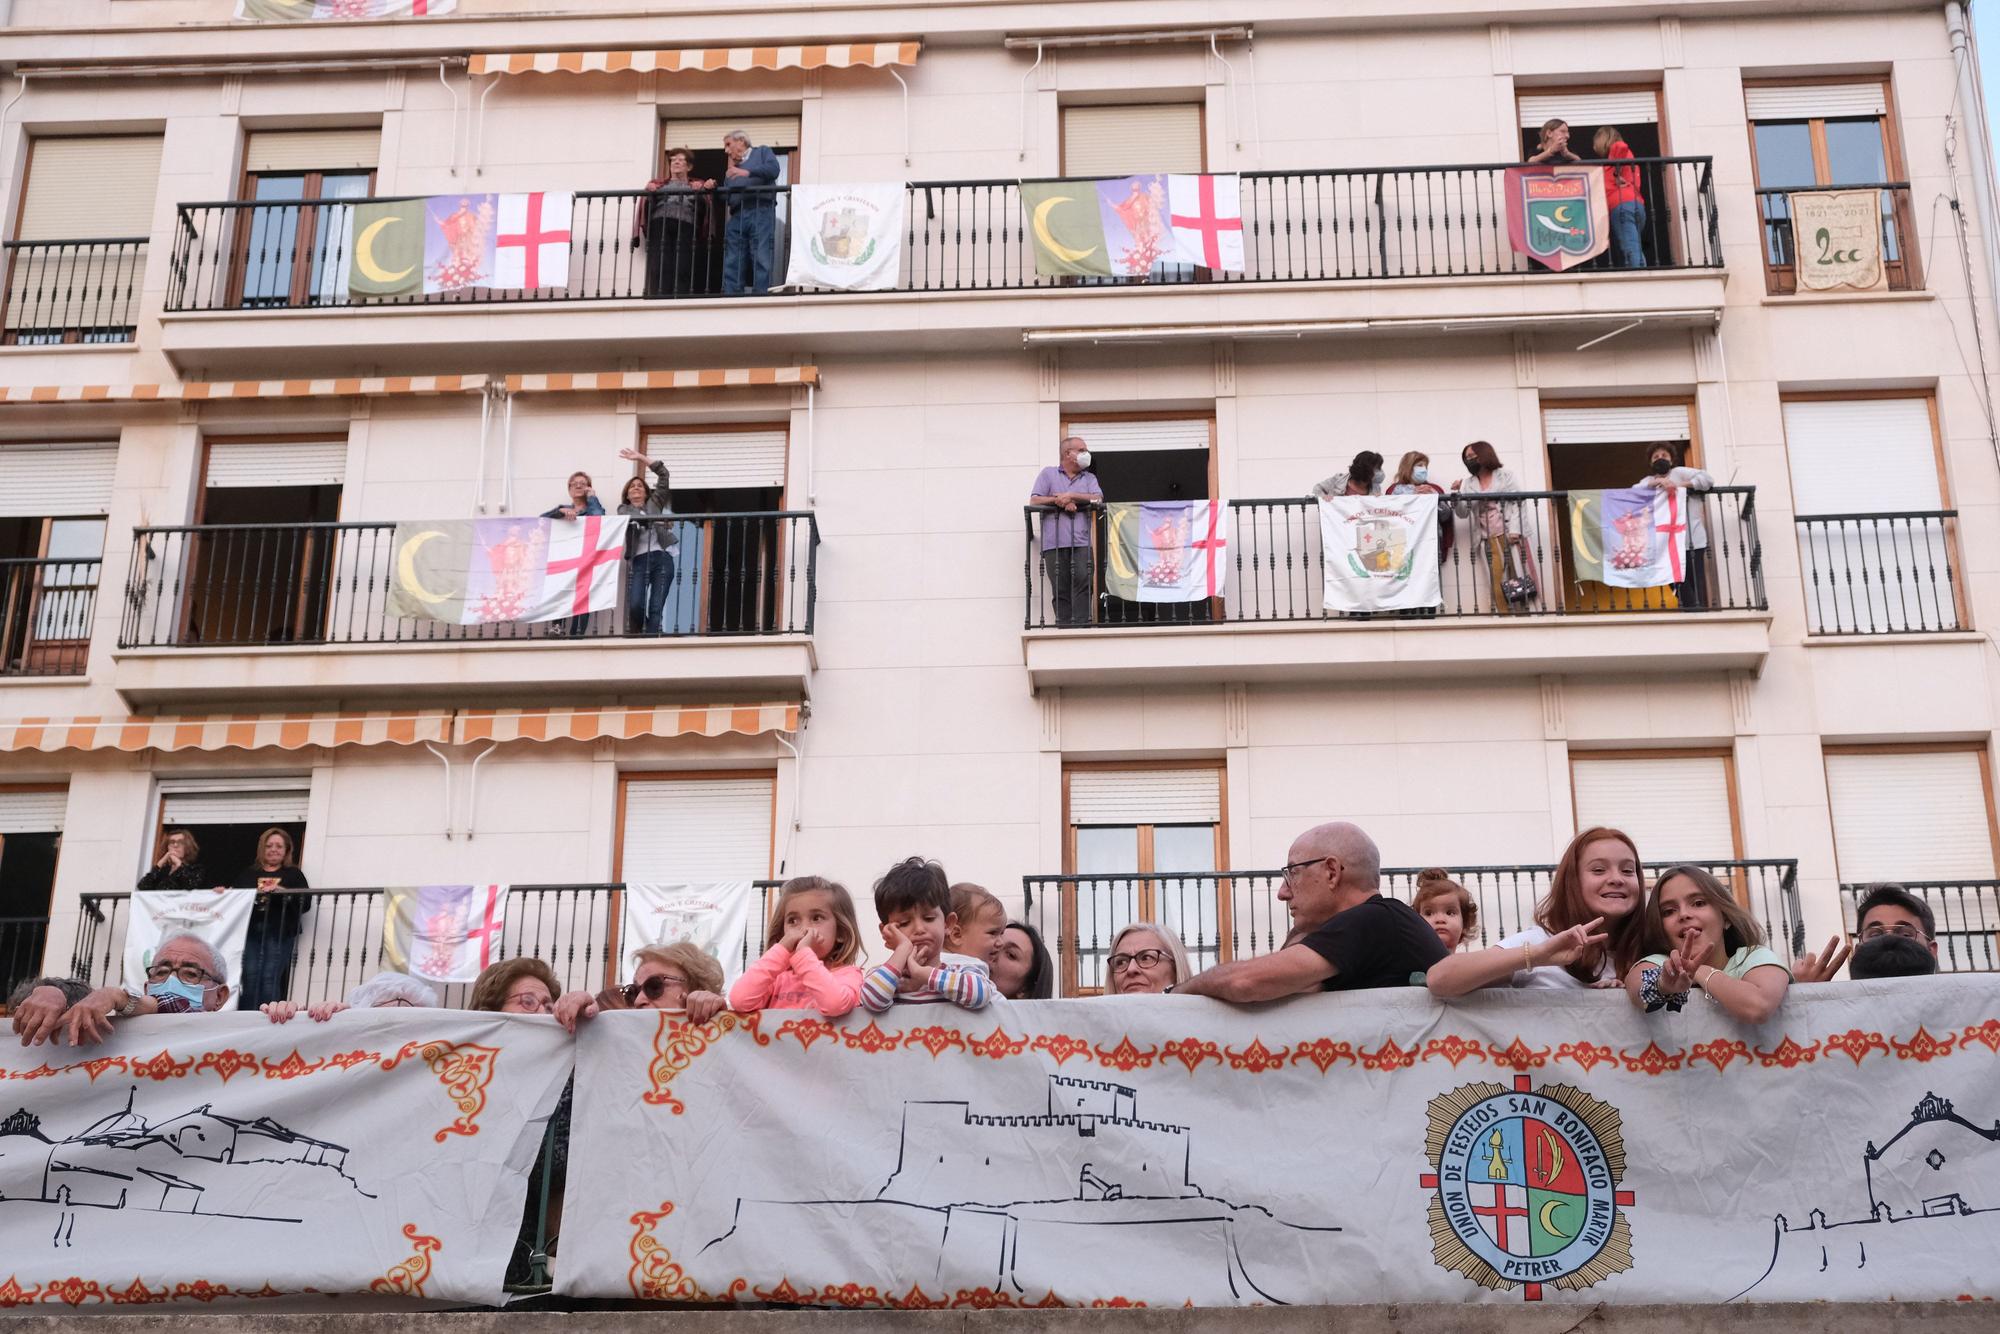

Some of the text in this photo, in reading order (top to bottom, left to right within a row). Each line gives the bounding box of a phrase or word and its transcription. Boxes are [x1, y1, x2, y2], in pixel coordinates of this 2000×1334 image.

[1445, 1097, 1610, 1247] UNION DE FESTEJOS SAN BONIFACIO MARTIR
[1503, 1259, 1563, 1277] PETRER
